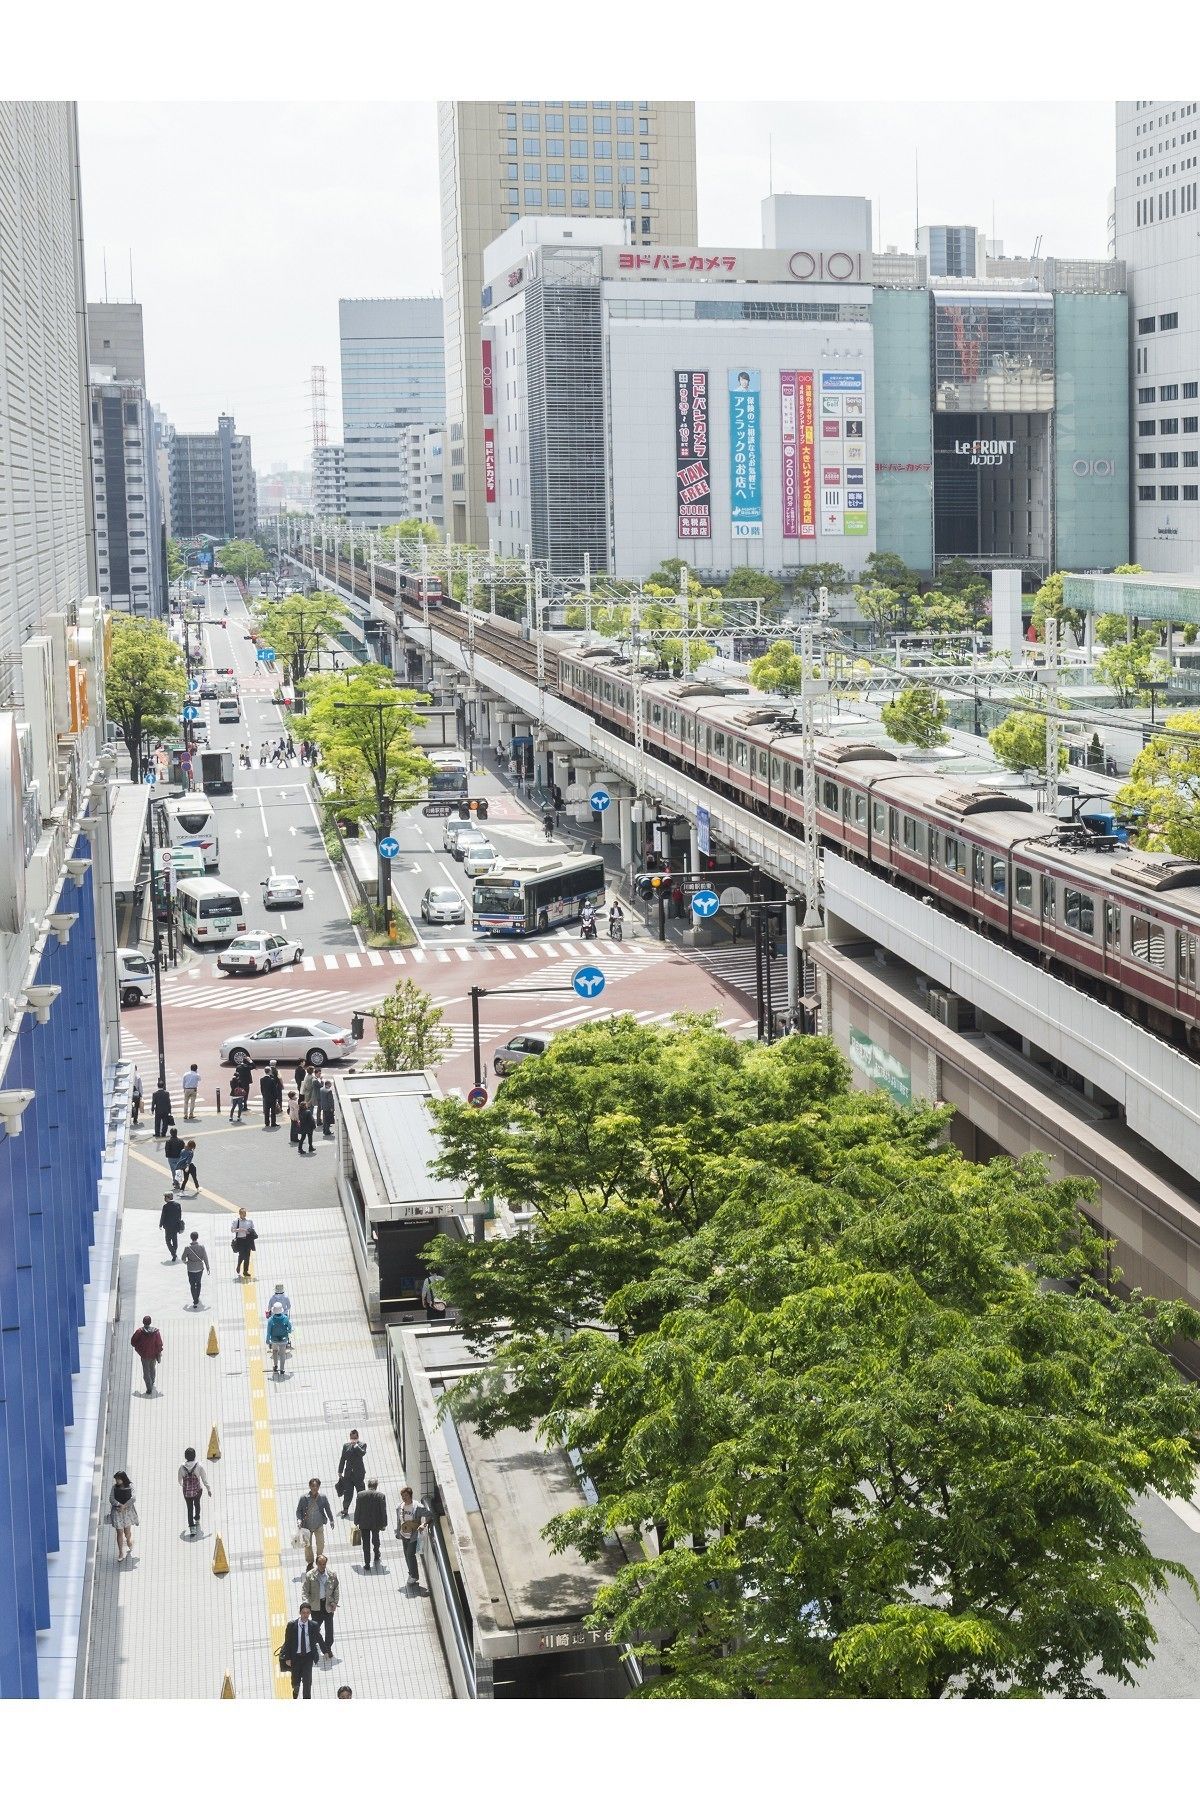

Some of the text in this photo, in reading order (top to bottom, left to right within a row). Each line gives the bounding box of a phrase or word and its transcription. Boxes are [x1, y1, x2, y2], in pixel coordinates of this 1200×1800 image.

[619, 253, 737, 271] ヨドバシカメラ
[692, 373, 706, 457] ヨドバシカメラ
[734, 396, 746, 499] アフラックのお店へ
[955, 440, 1016, 455] Le FRONT
[485, 441, 495, 490] ヨドバシカメラ
[875, 463, 931, 473] ヨドバシカメラ
[970, 455, 1003, 465] ルフロン
[676, 461, 708, 486] TAX
[679, 480, 710, 504] FREE
[802, 446, 812, 524] 大きいサイズの専門店
[680, 505, 708, 515] STORE
[735, 525, 760, 536] 10階
